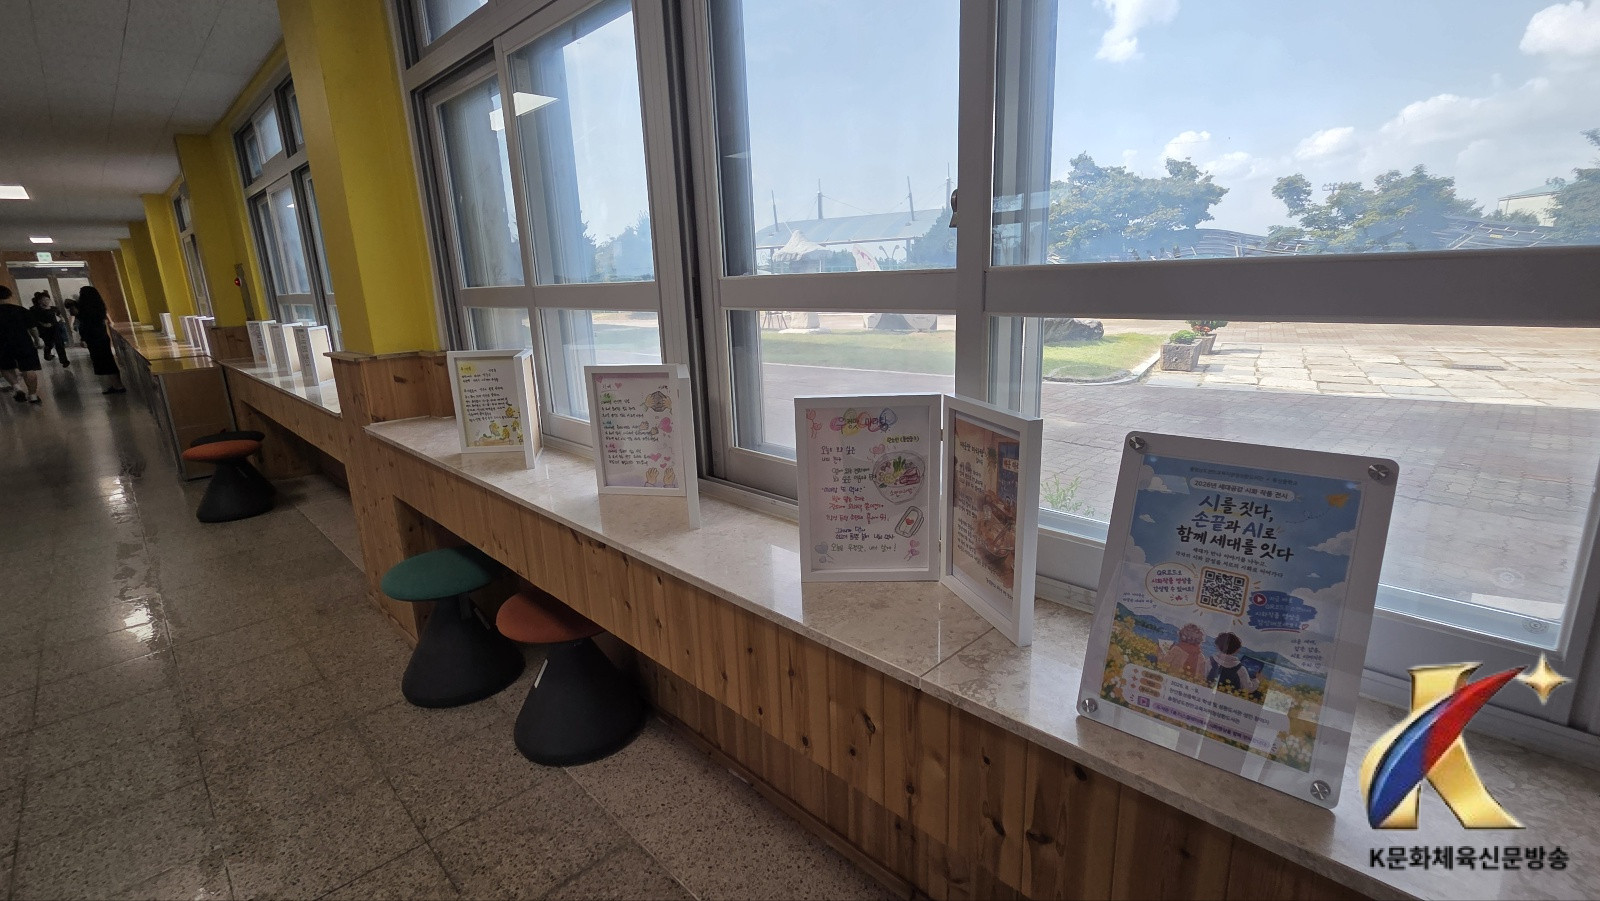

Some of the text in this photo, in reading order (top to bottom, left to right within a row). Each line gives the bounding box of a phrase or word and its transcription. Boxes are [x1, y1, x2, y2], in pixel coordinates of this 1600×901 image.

[1193, 480, 1216, 488] 2026년
[1218, 483, 1243, 492] 세대공감
[1244, 487, 1258, 495] 시화
[1259, 489, 1272, 497] 작품
[1199, 493, 1273, 522] 시를 짓다,
[1192, 511, 1277, 540] 손끝과 AI로
[1176, 525, 1294, 562] 함께 세대를 잇다
